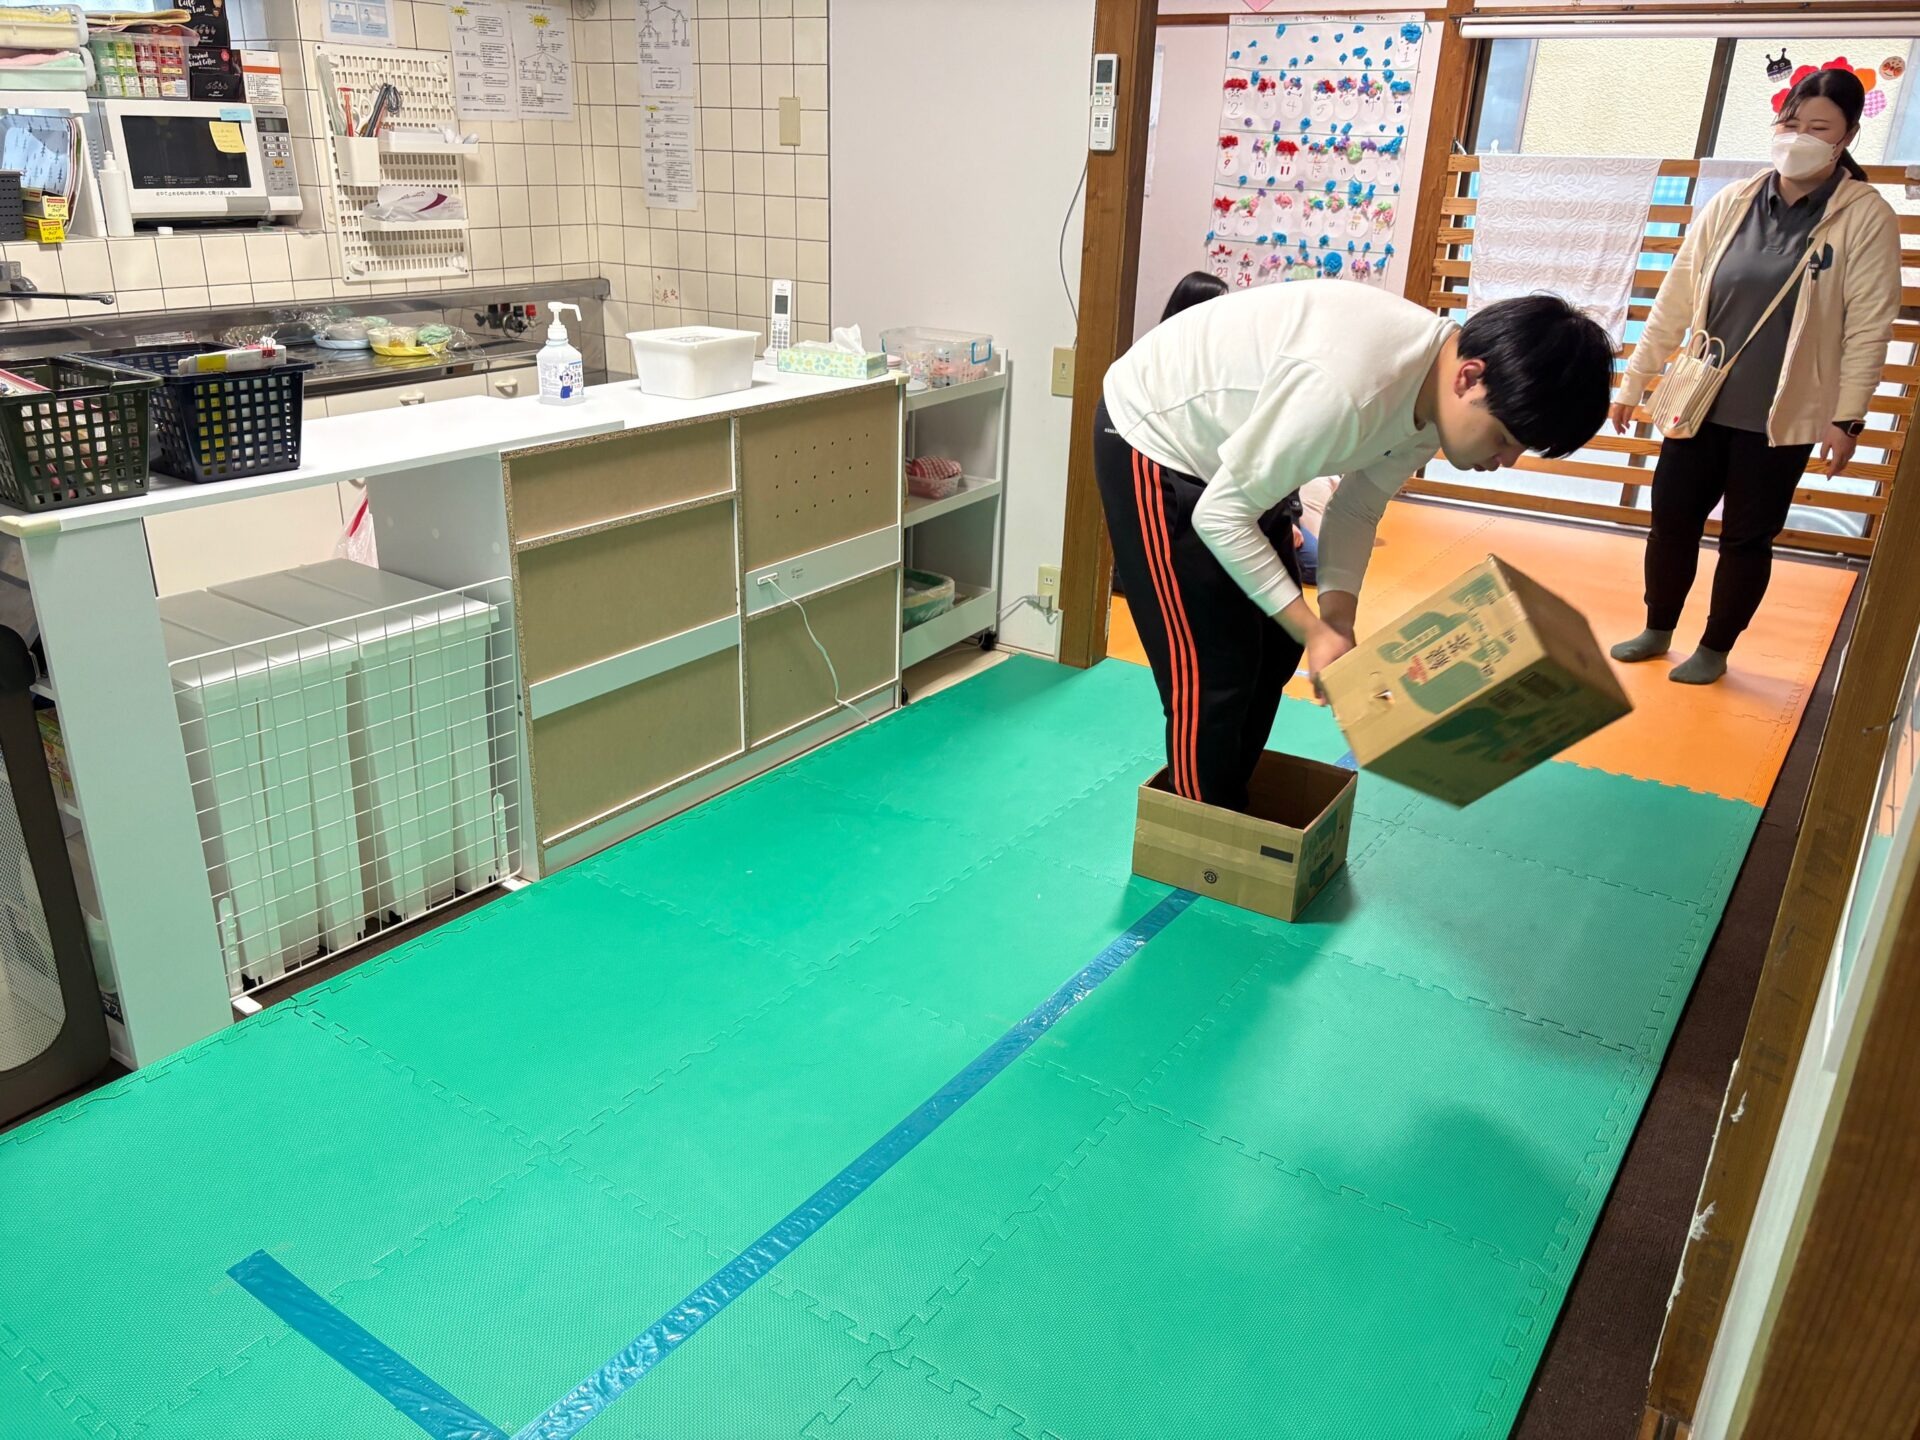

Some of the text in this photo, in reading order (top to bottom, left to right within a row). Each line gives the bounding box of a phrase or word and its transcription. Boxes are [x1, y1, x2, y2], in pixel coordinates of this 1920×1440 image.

[1230, 102, 1239, 116] 2
[1286, 100, 1297, 112] 4
[1224, 158, 1231, 169] 9
[1280, 165, 1290, 175] 11
[1216, 266, 1253, 288] 23 24
